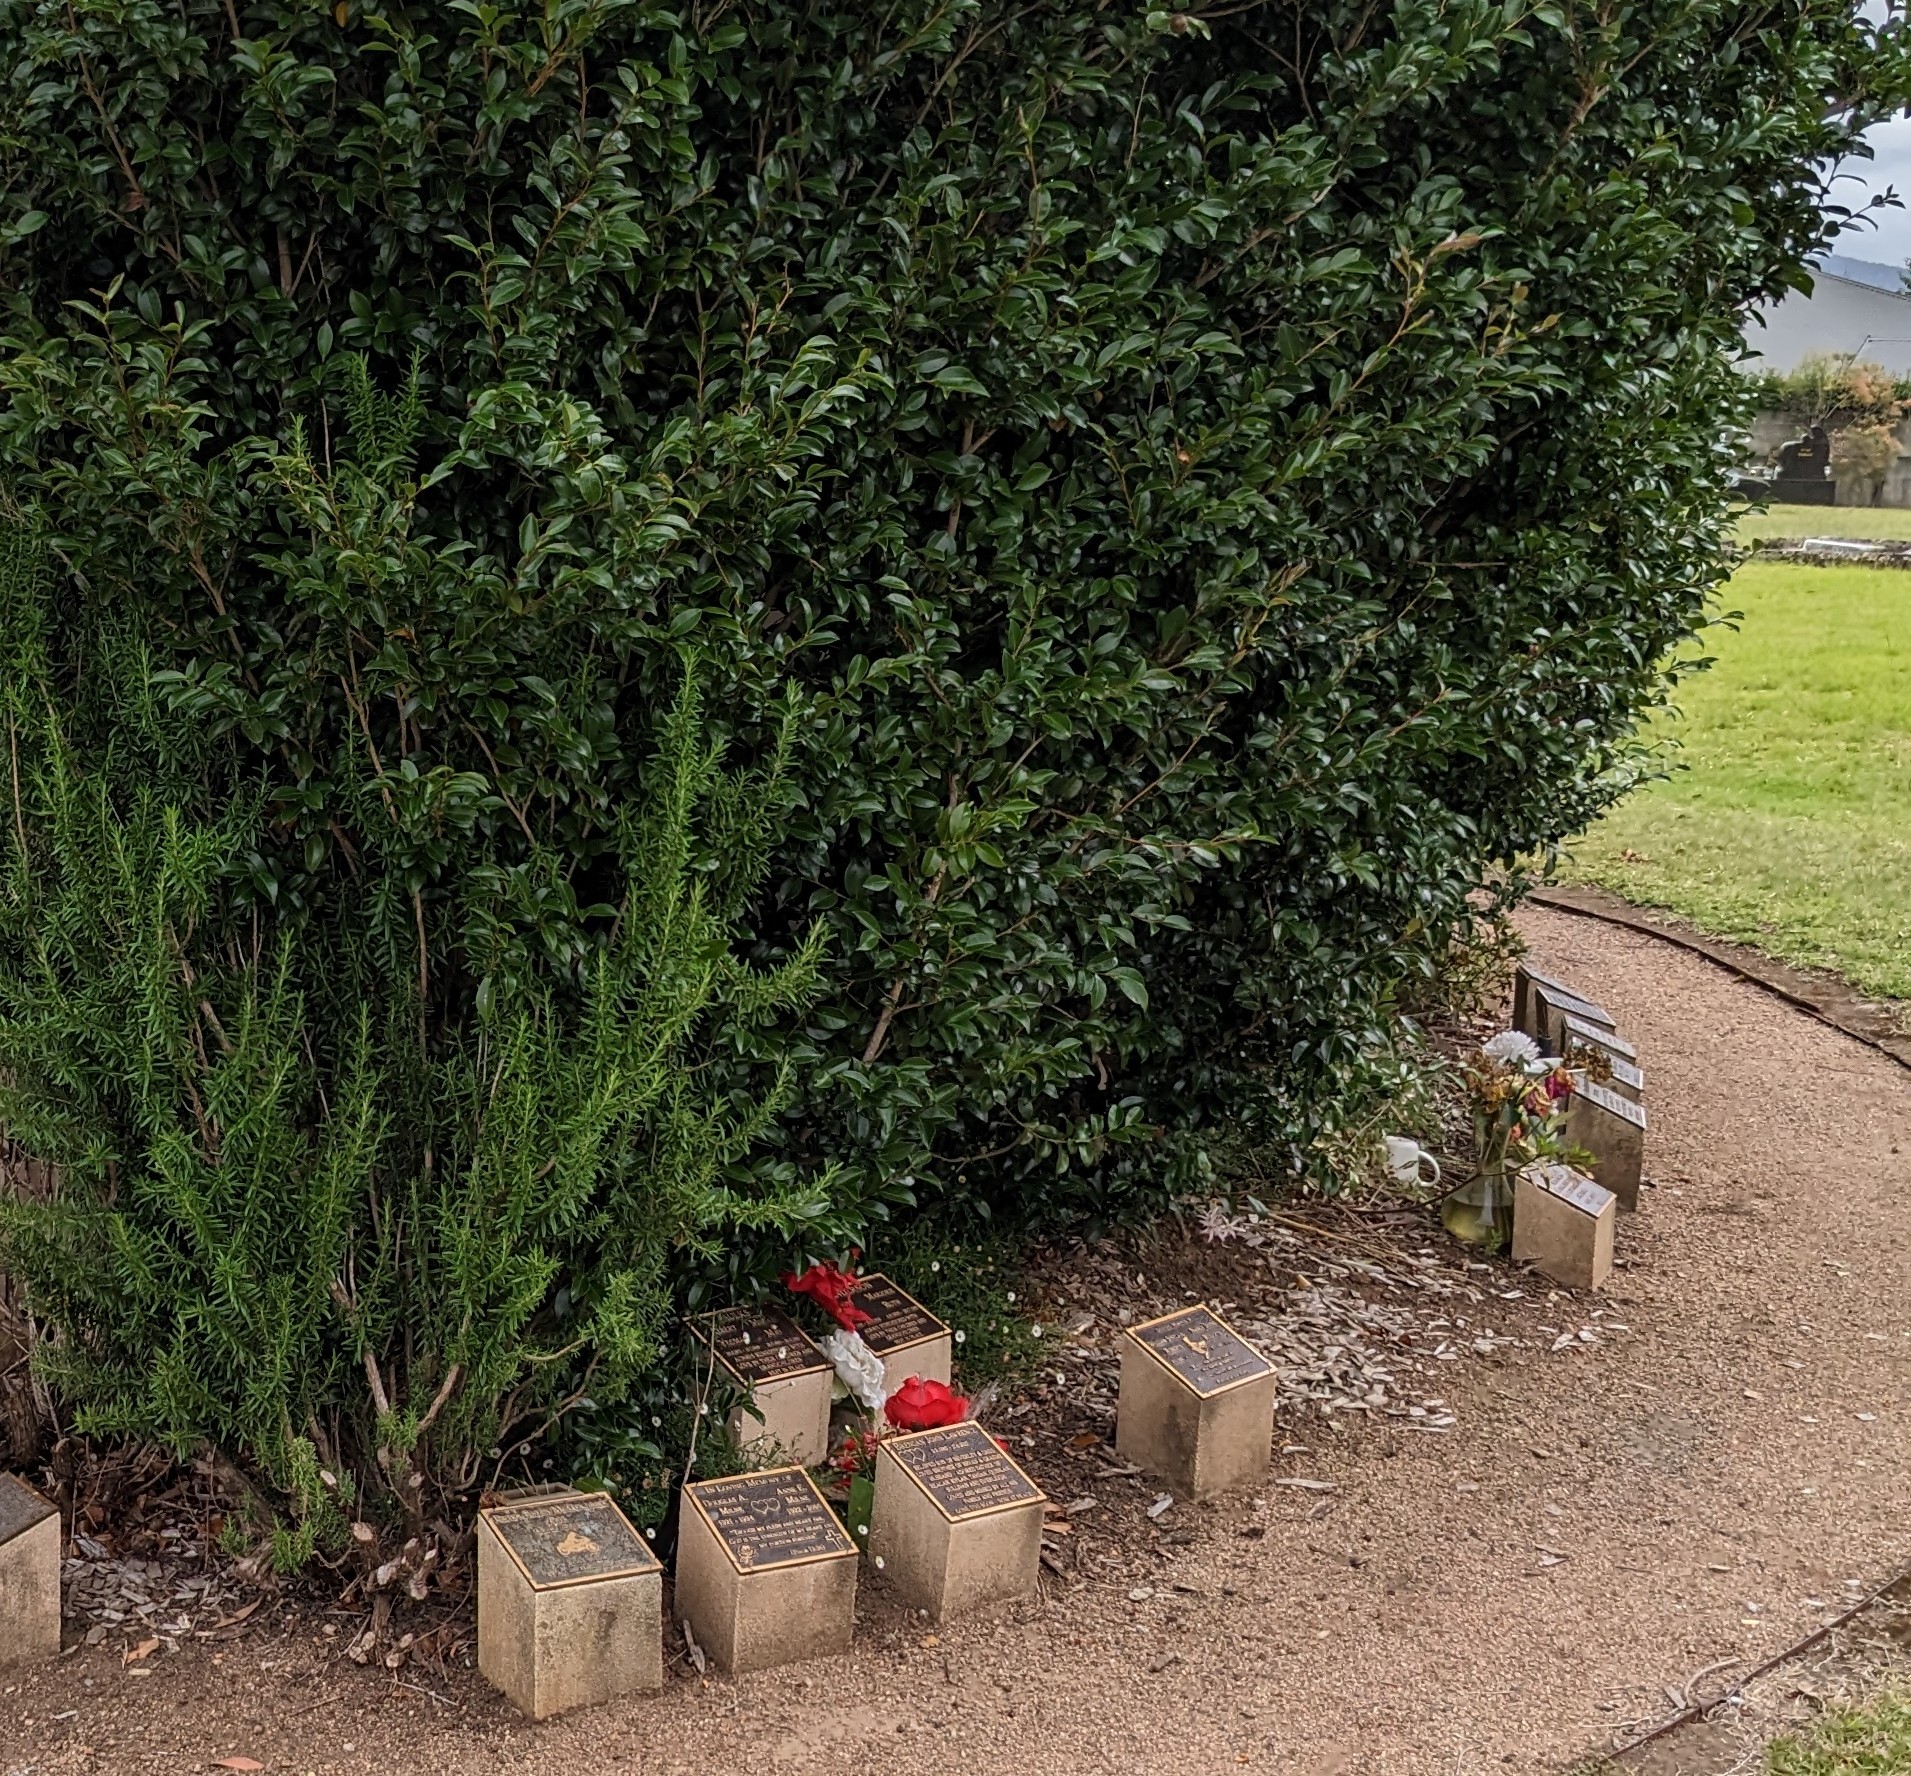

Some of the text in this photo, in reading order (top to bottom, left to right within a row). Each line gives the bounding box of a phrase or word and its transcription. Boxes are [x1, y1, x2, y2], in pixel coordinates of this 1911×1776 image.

[715, 1482, 746, 1492] LOVING
[745, 1476, 780, 1487] MEMORY
[774, 1486, 797, 1495] ANNE
[702, 1496, 737, 1507] DOUGLAS
